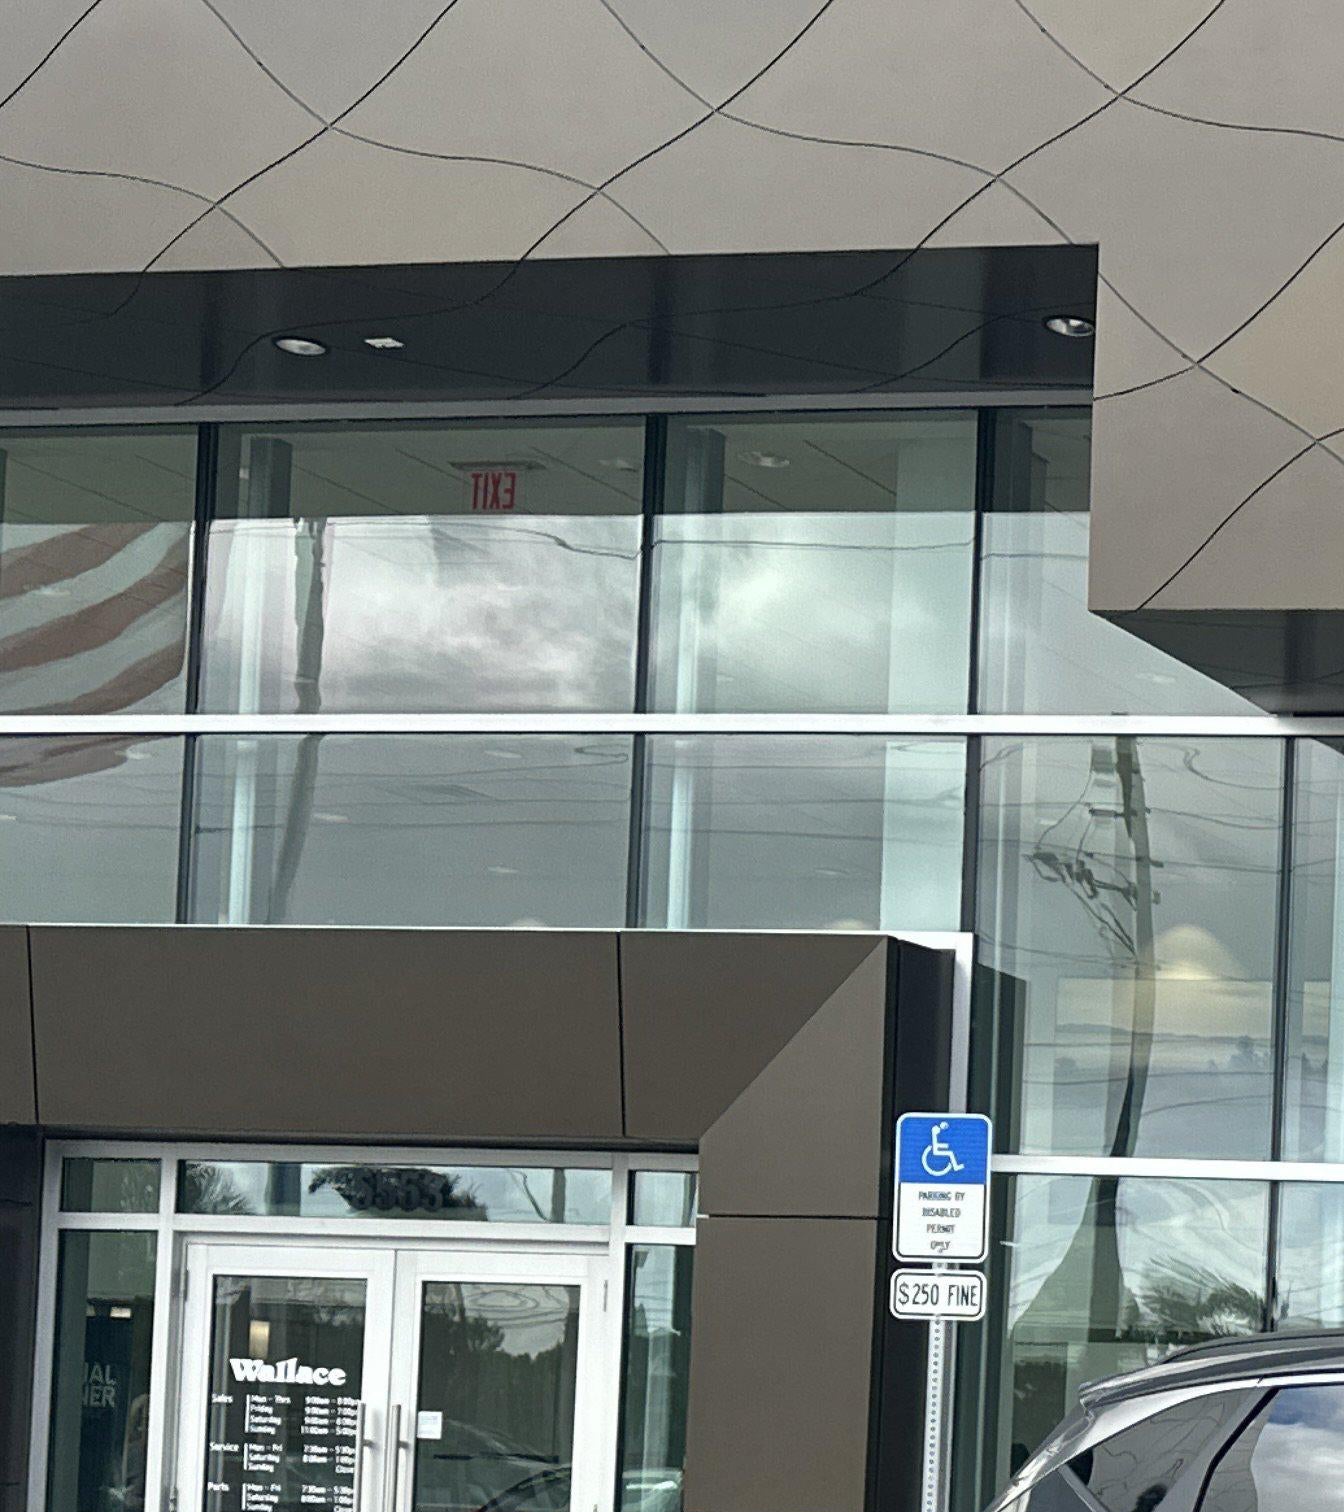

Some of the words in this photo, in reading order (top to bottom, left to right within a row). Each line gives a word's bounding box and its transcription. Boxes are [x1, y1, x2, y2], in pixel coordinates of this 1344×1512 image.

[918, 1191, 952, 1201] PARKING
[921, 1207, 961, 1218] DISABLED
[926, 1223, 956, 1234] PERMIT
[897, 1281, 940, 1306] $250
[947, 1284, 978, 1307] FINE
[229, 1357, 347, 1386] Wallace
[209, 1442, 239, 1452] Service
